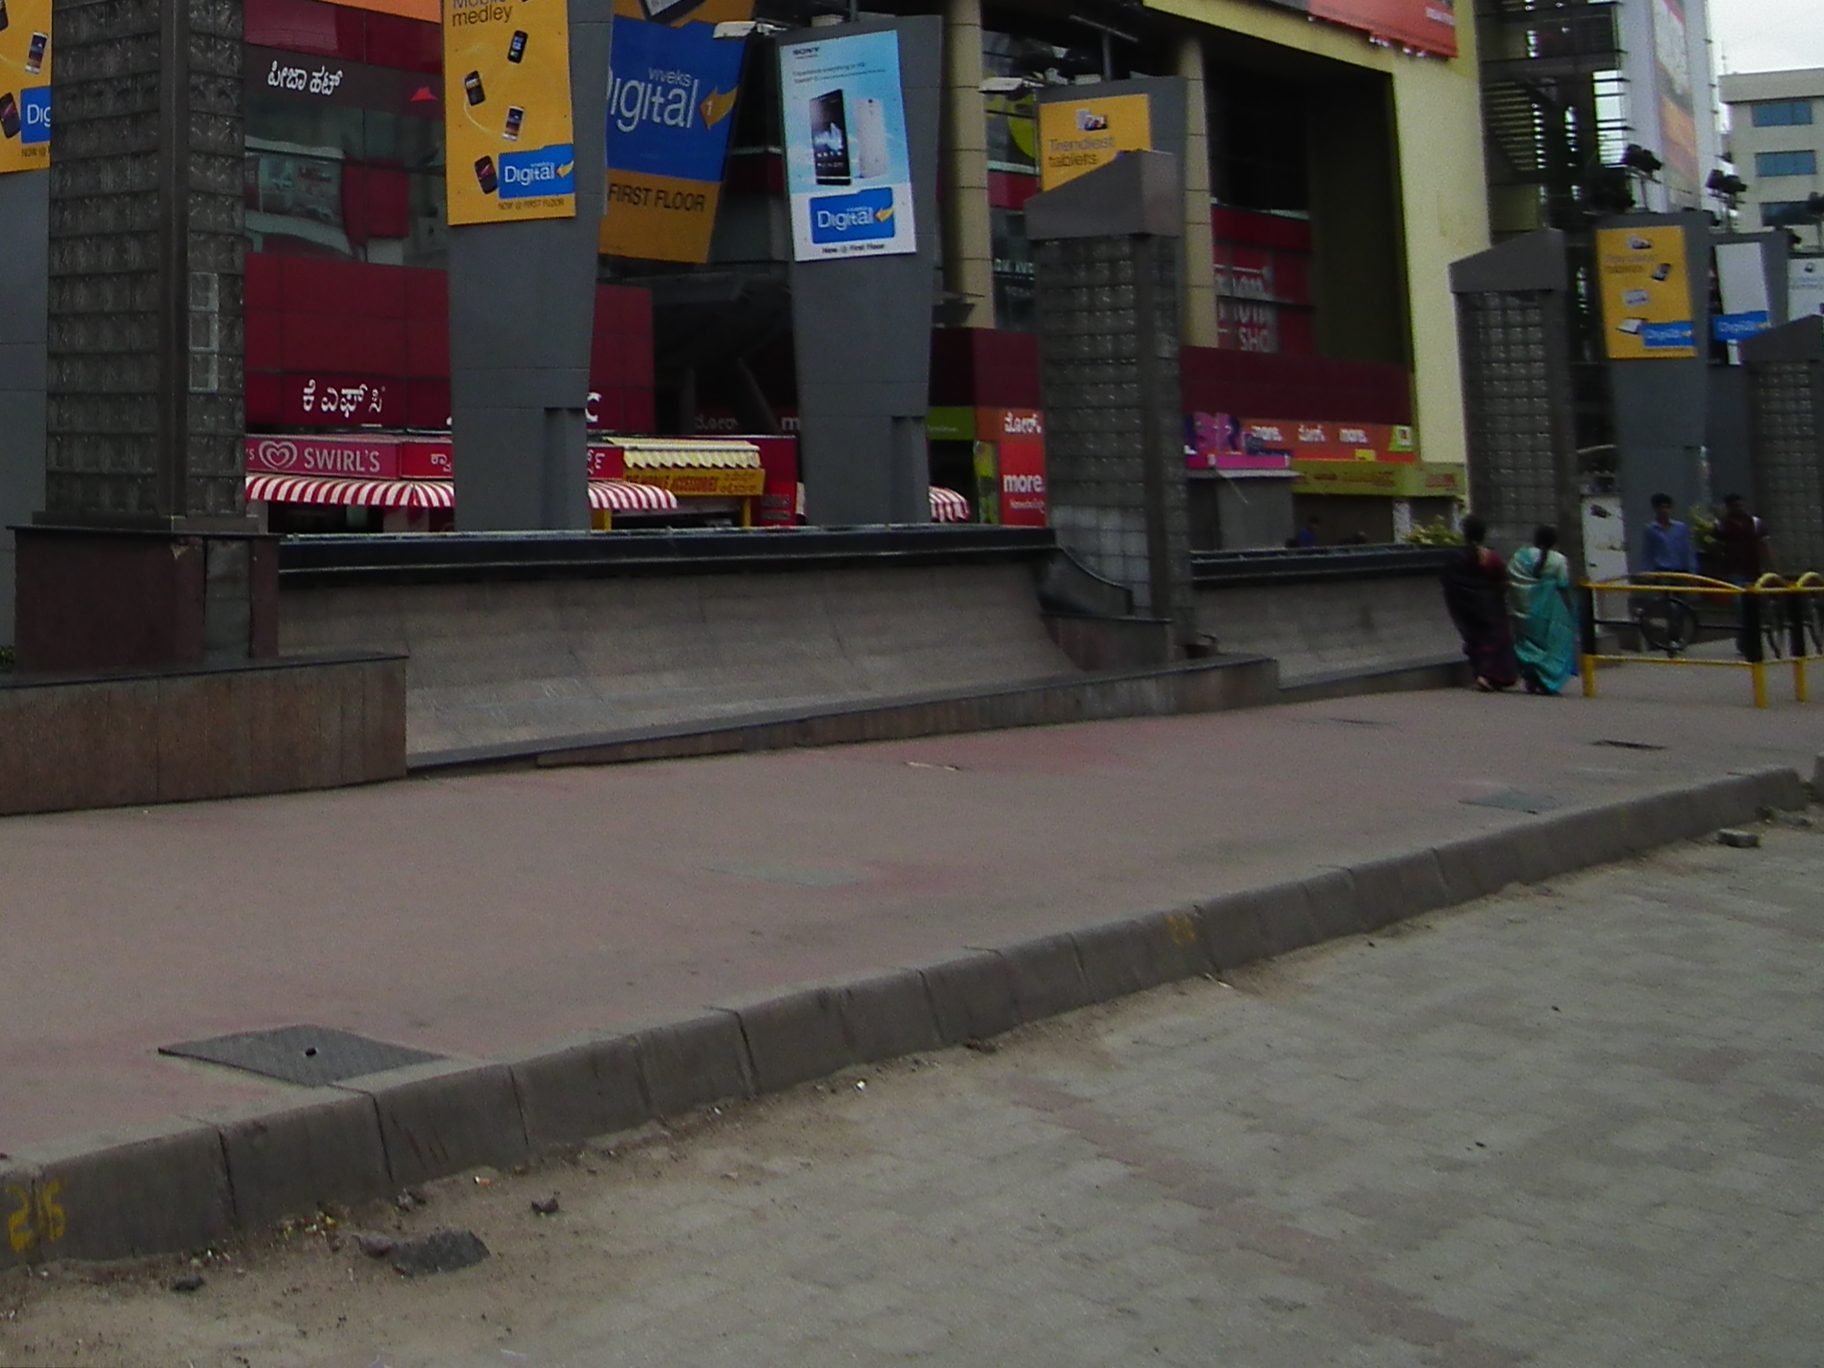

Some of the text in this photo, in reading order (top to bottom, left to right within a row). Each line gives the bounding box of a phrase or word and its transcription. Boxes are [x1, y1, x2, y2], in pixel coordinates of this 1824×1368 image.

[452, 3, 513, 27] medley
[648, 66, 693, 88] viveks
[504, 163, 555, 186] Digital
[654, 189, 706, 212] FLOOR
[817, 206, 875, 232] Digital
[302, 379, 316, 411] ಕೆ
[303, 447, 381, 473] SWIRL'S
